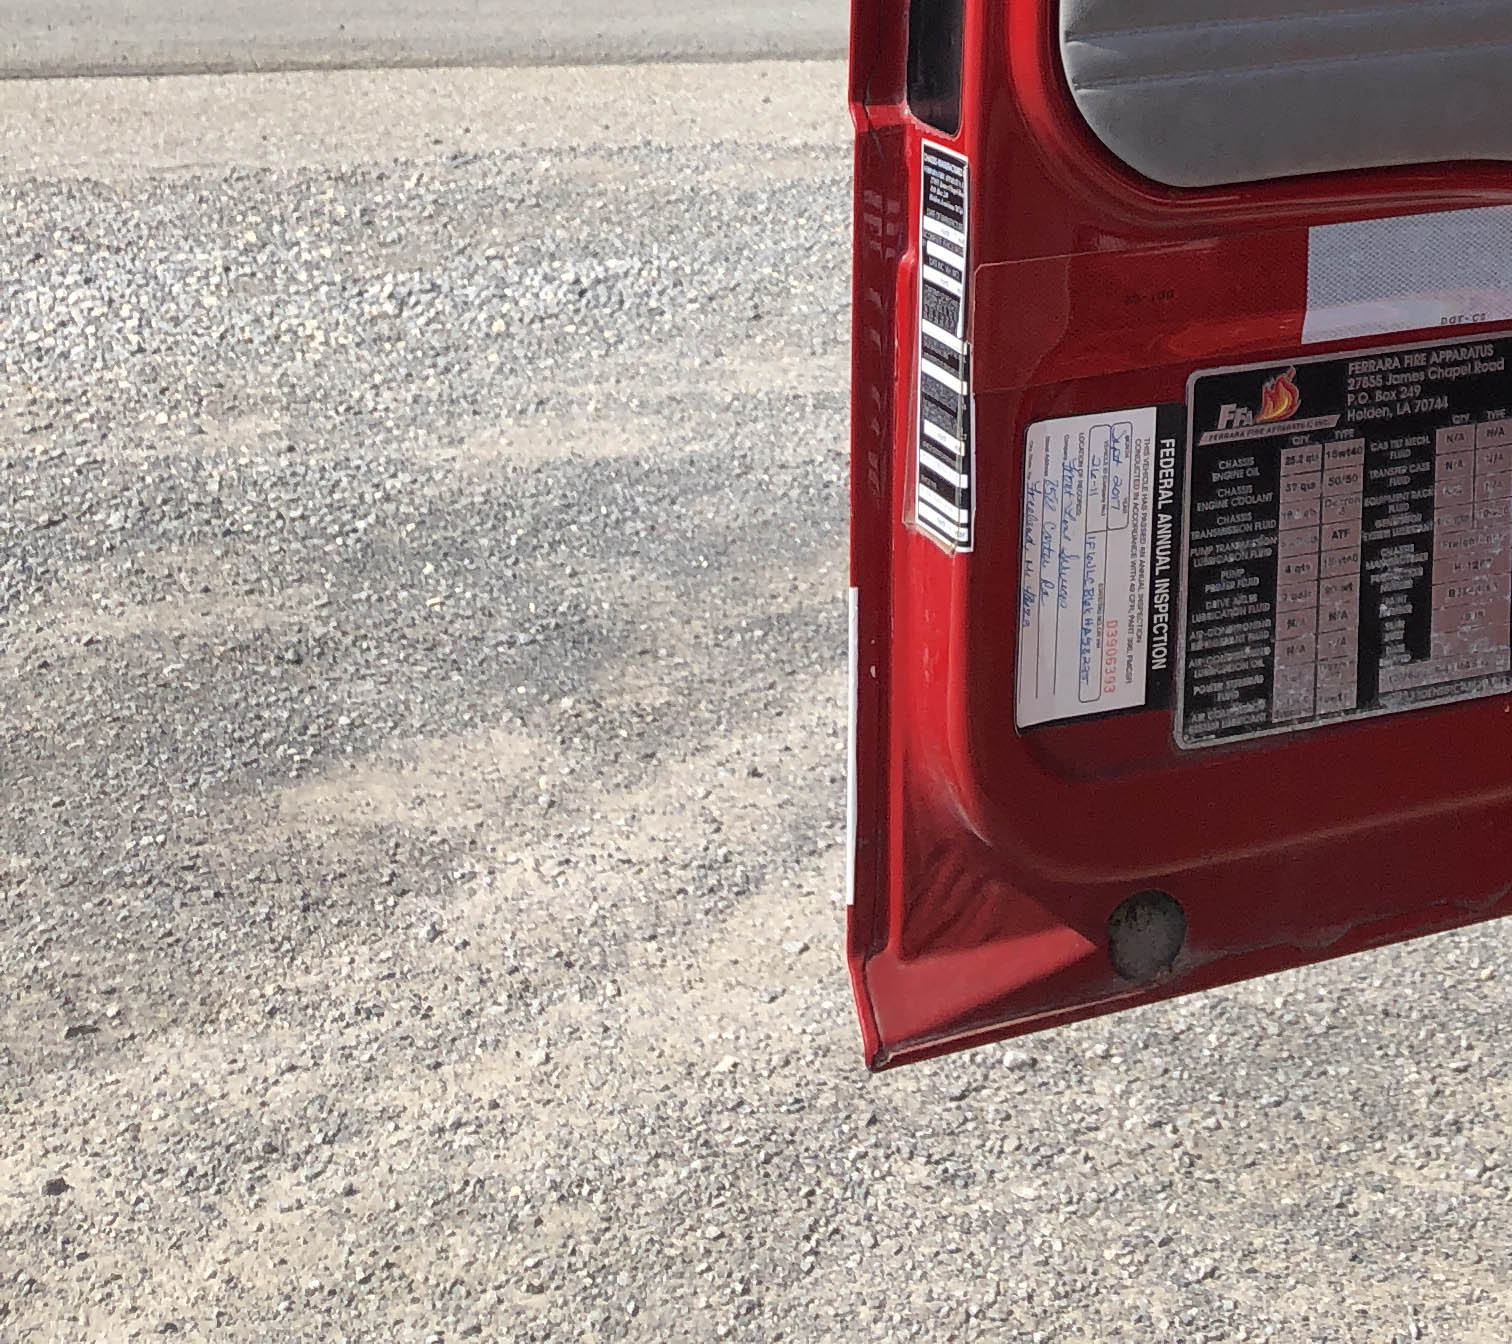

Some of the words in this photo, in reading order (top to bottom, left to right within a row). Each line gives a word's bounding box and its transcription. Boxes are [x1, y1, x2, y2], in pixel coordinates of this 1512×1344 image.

[1349, 357, 1400, 375] FERRARA
[1404, 353, 1427, 368] FIRE
[1430, 344, 1494, 364] APPARATUS
[1387, 371, 1425, 386] James
[1428, 364, 1472, 381] Chapel
[1474, 357, 1505, 374] Road
[1347, 392, 1369, 406] P.O.
[1375, 389, 1397, 402] Box
[1400, 385, 1422, 398] 249
[1347, 406, 1393, 422] Holden,
[1397, 401, 1411, 415] LA
[1414, 396, 1448, 412] 70744
[1487, 409, 1505, 419] TYPE
[1209, 427, 1244, 441] FERRARA
[1246, 427, 1265, 437] FIRE
[1334, 429, 1355, 439] TYPE
[1446, 432, 1465, 443] N/A
[1077, 433, 1085, 467] LOCATION
[1133, 439, 1141, 491] CONDUCTED
[1218, 457, 1255, 470] CHASSIS
[1409, 462, 1431, 473] CASE
[1141, 458, 1149, 492] VEHICLE
[1158, 439, 1176, 510] FEDERAL
[1211, 470, 1244, 482] ENGINE
[1246, 467, 1260, 477] OIL
[1111, 475, 1122, 510] 2017
[1133, 492, 1140, 500] IN
[1217, 485, 1253, 498] CHASSIS
[1197, 498, 1230, 512] ENGINE
[1231, 492, 1274, 507] COOLANT
[1217, 512, 1252, 525] CHASSIS
[1254, 519, 1277, 530] FLUID
[1130, 503, 1139, 559] ACCORDANCE
[1332, 528, 1350, 539] ATF
[1139, 546, 1146, 558] AN
[1155, 513, 1173, 575] ANNUAL
[1190, 544, 1214, 557] PUMP
[1137, 560, 1145, 592] ANNUAL
[1220, 568, 1245, 579] PUMP
[1127, 615, 1135, 635] PART
[1136, 593, 1144, 643] INSPECTION
[1151, 579, 1170, 670] INSPECTION
[1103, 619, 1118, 694] D3906393
